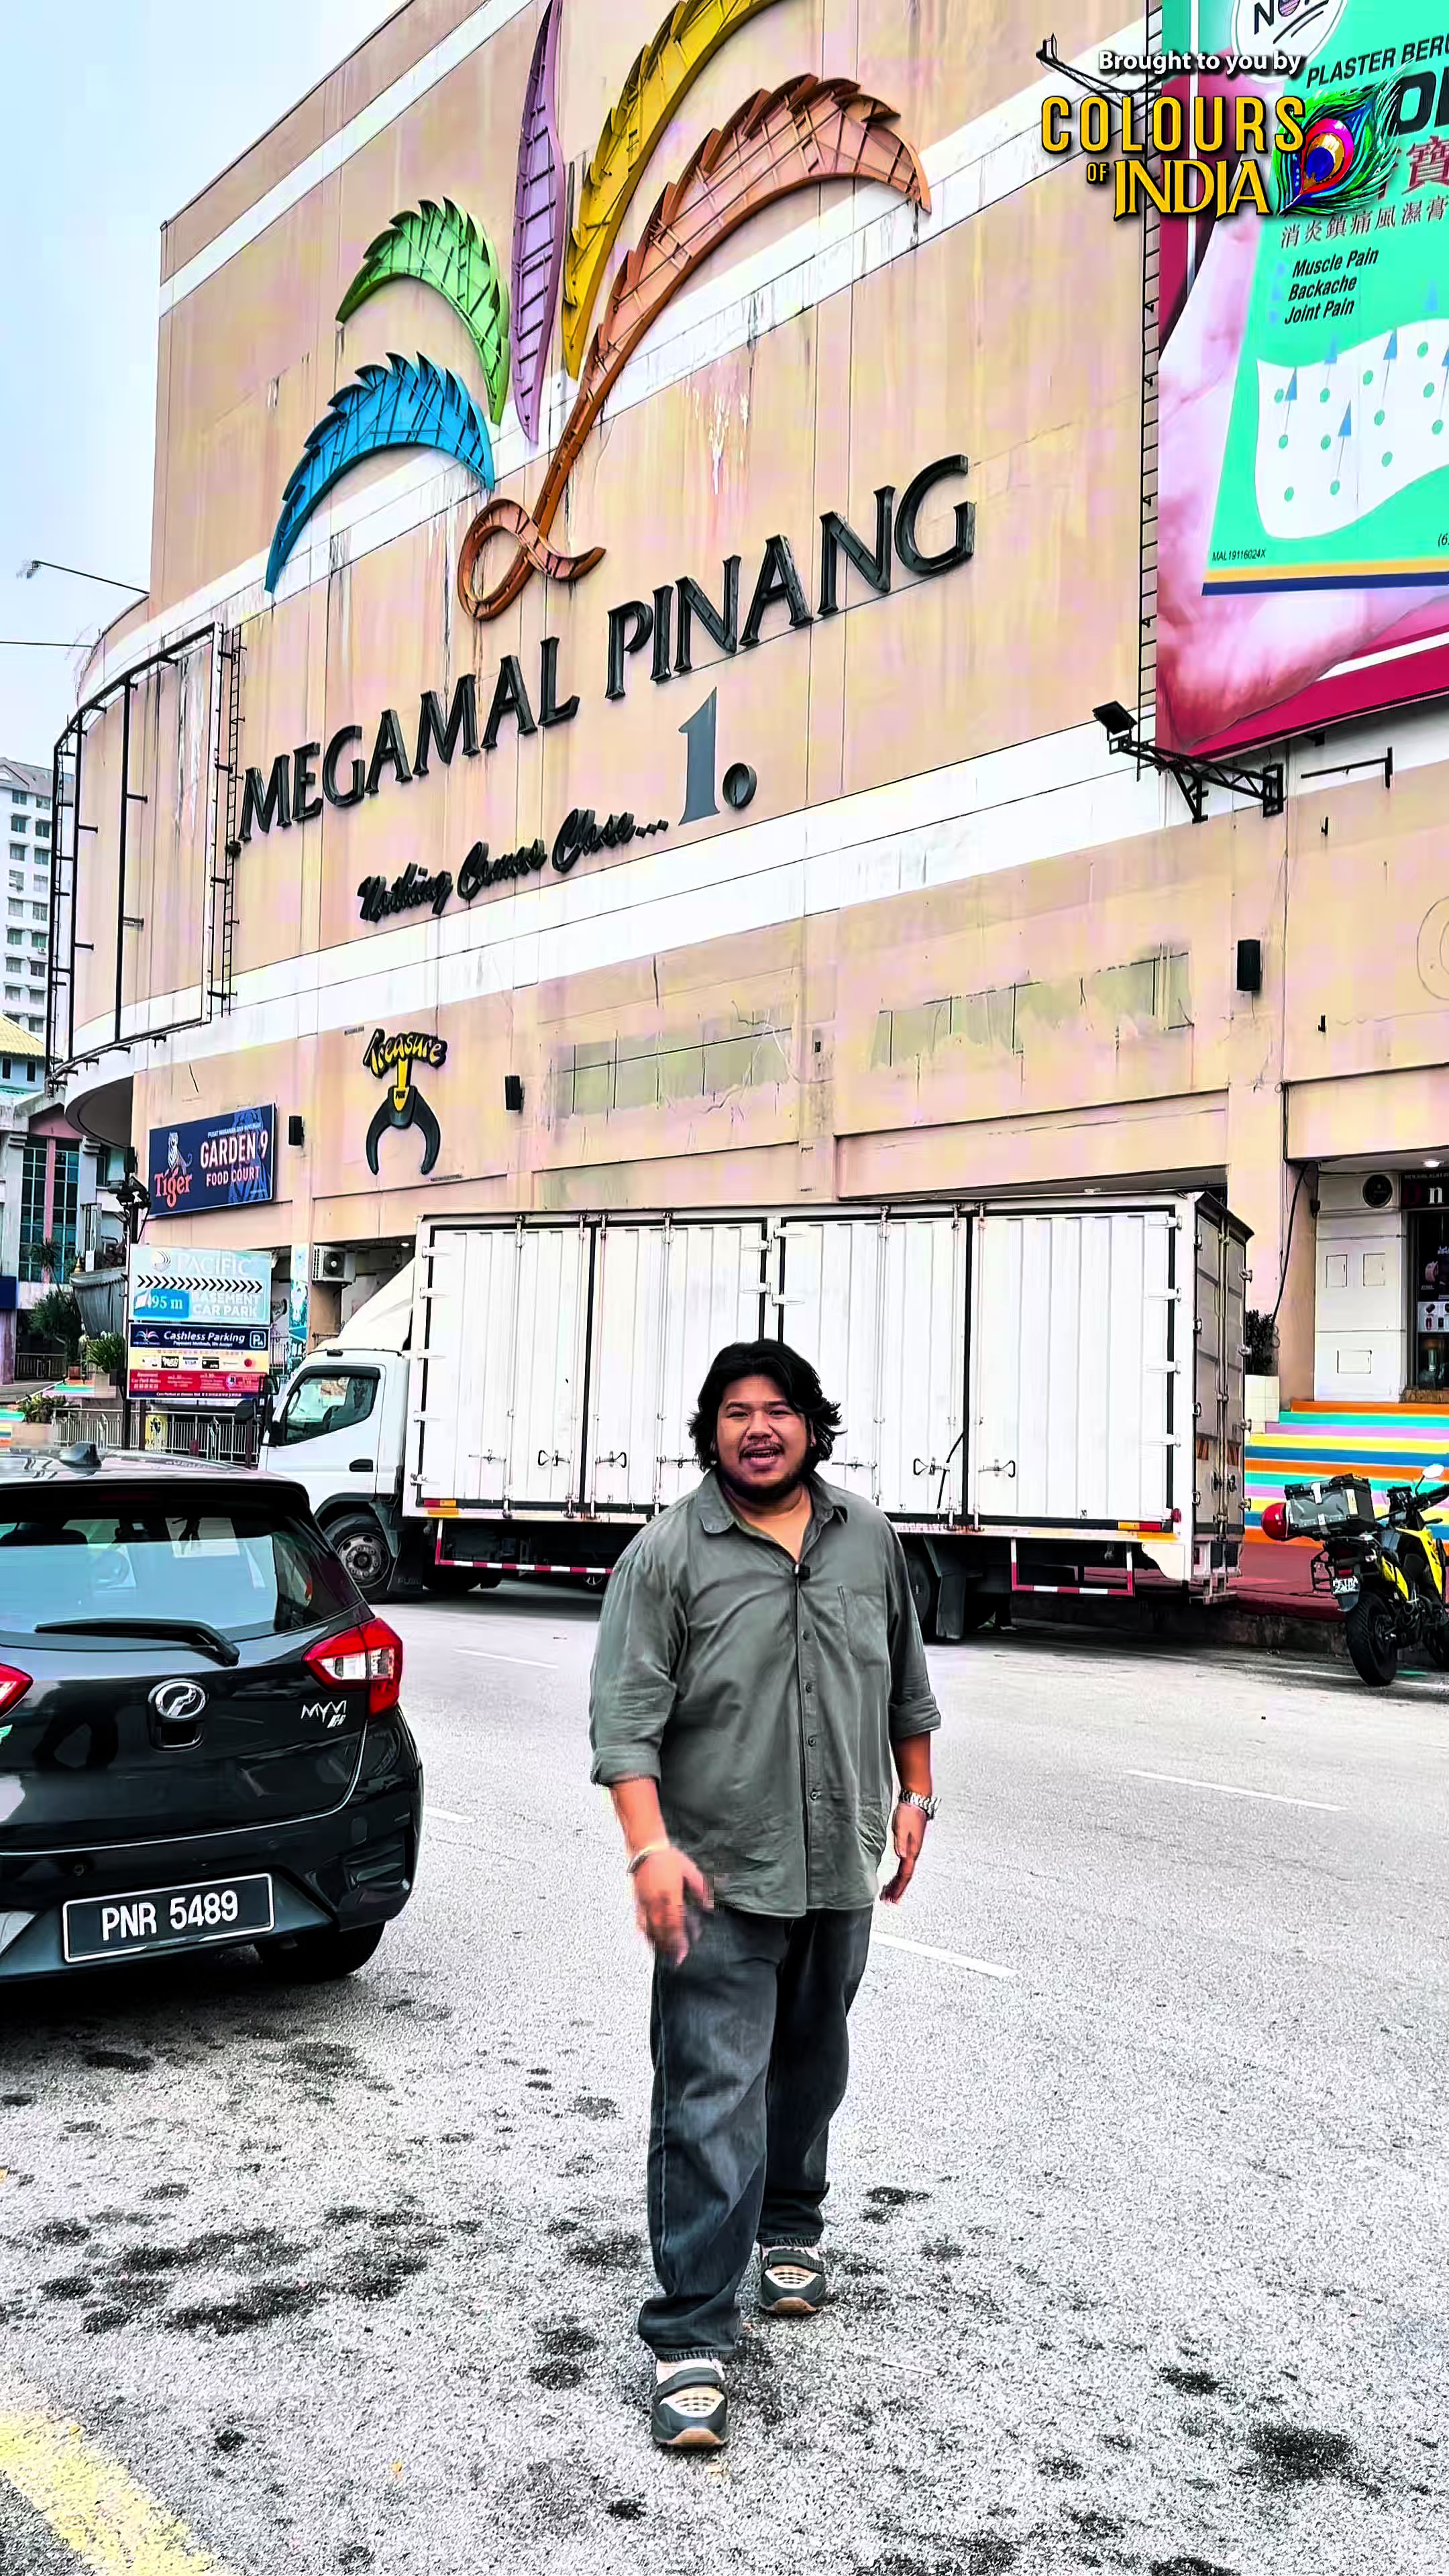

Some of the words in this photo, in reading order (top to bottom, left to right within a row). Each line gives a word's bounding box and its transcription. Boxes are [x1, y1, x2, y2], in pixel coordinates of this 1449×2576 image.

[1306, 48, 1396, 89] PLASTER
[1292, 254, 1342, 278] Muscle
[1346, 247, 1379, 268] Pain
[1288, 274, 1358, 302] Backache
[1284, 303, 1322, 325] Joint
[1323, 298, 1355, 319] Pain
[238, 637, 580, 841] MEGAMAL
[605, 454, 976, 701] PINANG
[458, 838, 547, 900] Comes
[201, 1132, 256, 1169] GARDEN
[260, 1129, 268, 1160] 9
[154, 1167, 193, 1208] Tiger
[206, 1171, 229, 1187] FOOD
[231, 1166, 260, 1183] COURT
[177, 1253, 252, 1275] PACIFIC
[170, 1298, 183, 1310] m
[193, 1304, 220, 1316] CAR
[224, 1306, 258, 1318] PARK
[164, 1330, 205, 1341] Cashless
[207, 1332, 246, 1344] Parking
[102, 1902, 157, 1941] PNR
[170, 1890, 238, 1929] 5489
